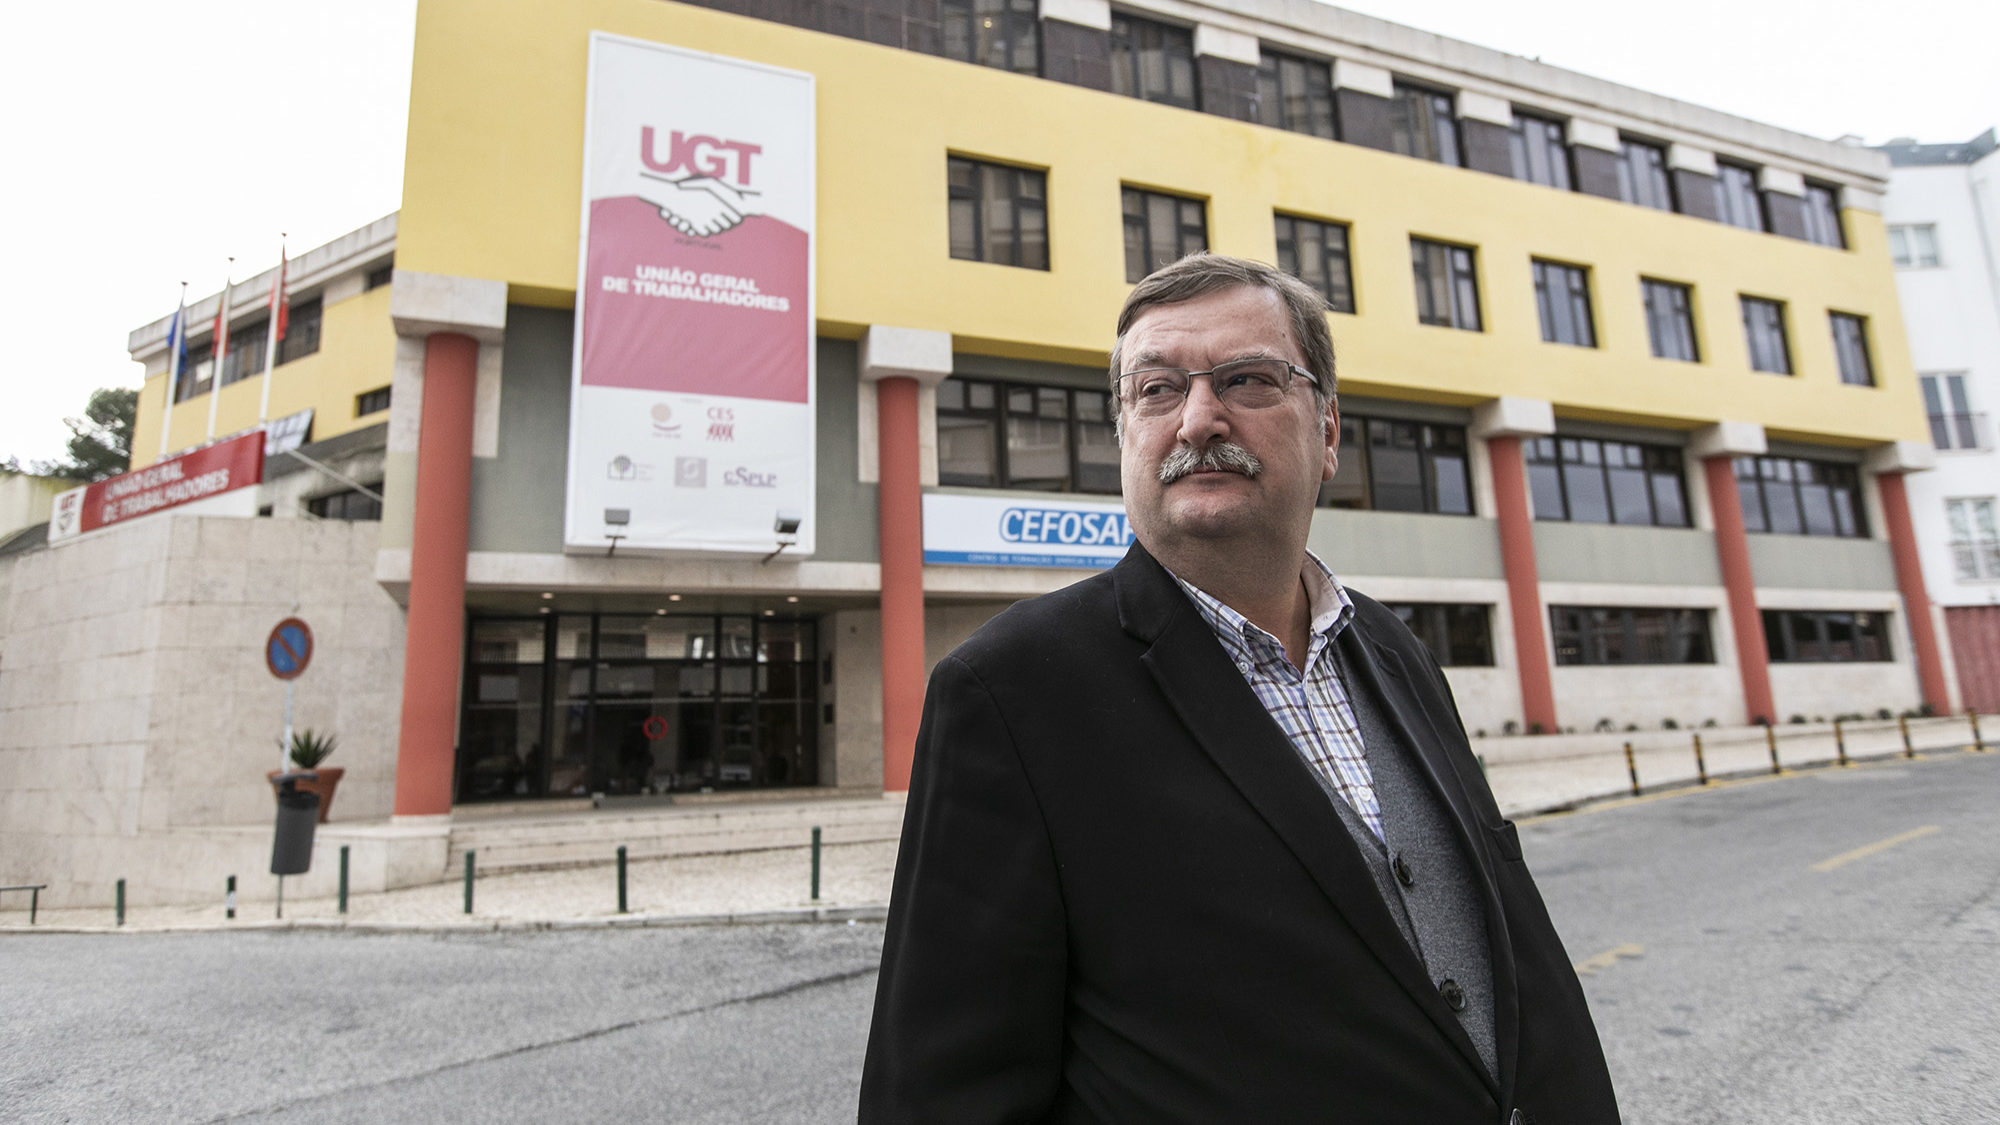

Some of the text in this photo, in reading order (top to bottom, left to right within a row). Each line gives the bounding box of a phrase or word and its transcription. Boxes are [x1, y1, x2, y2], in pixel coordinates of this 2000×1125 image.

[640, 125, 762, 186] UGT
[602, 276, 790, 312] DE TRABALHADORES
[635, 264, 759, 293] UNIÃO GERAL
[706, 406, 735, 421] CES
[143, 461, 185, 489] GERAL
[102, 468, 230, 524] DE TRABALHADORES
